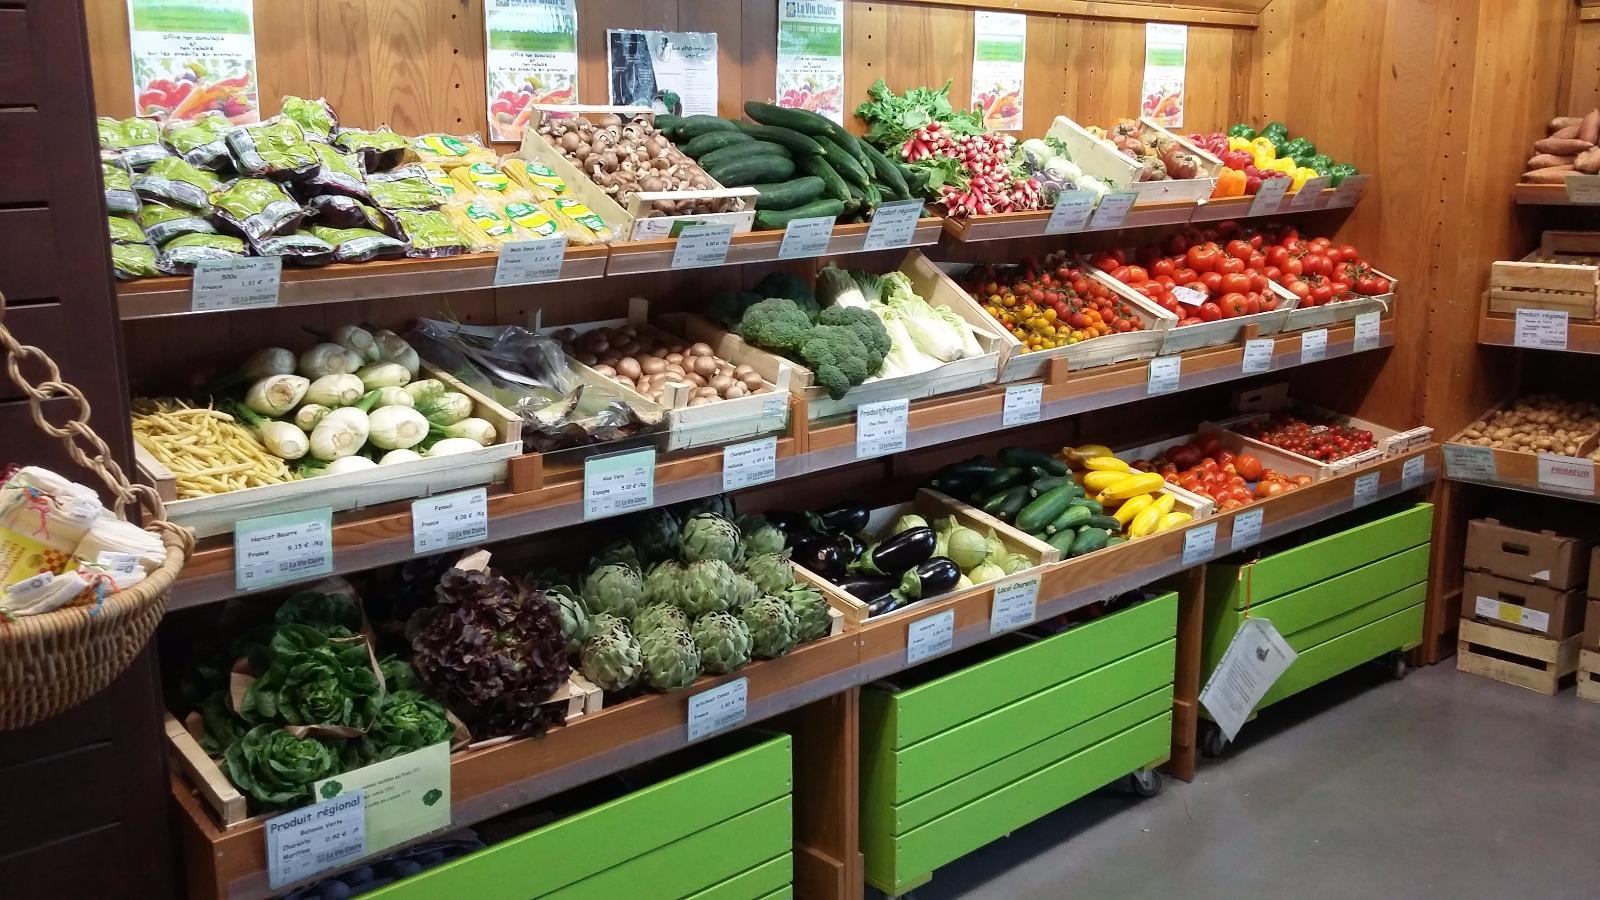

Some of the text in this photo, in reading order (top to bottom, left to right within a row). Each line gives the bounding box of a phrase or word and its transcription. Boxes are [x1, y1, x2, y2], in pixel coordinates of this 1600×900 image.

[797, 2, 804, 13] La
[806, 3, 816, 14] Vie
[817, 4, 837, 17] Claire
[202, 266, 233, 274] Betterave
[860, 403, 906, 418] Produit régional
[1551, 466, 1590, 478] PRIMEUR
[434, 503, 453, 511] Fenouil
[251, 530, 298, 542] Haricot Beurre
[248, 551, 269, 559] France
[297, 559, 307, 567] Vie
[307, 556, 325, 566] Claire
[997, 578, 1038, 594] Local Charente
[270, 795, 361, 834] Produit régional
[299, 819, 343, 836] Batavia Verte
[282, 839, 311, 851] Charente
[345, 843, 363, 853] Claire
[282, 848, 311, 860] Maritime
